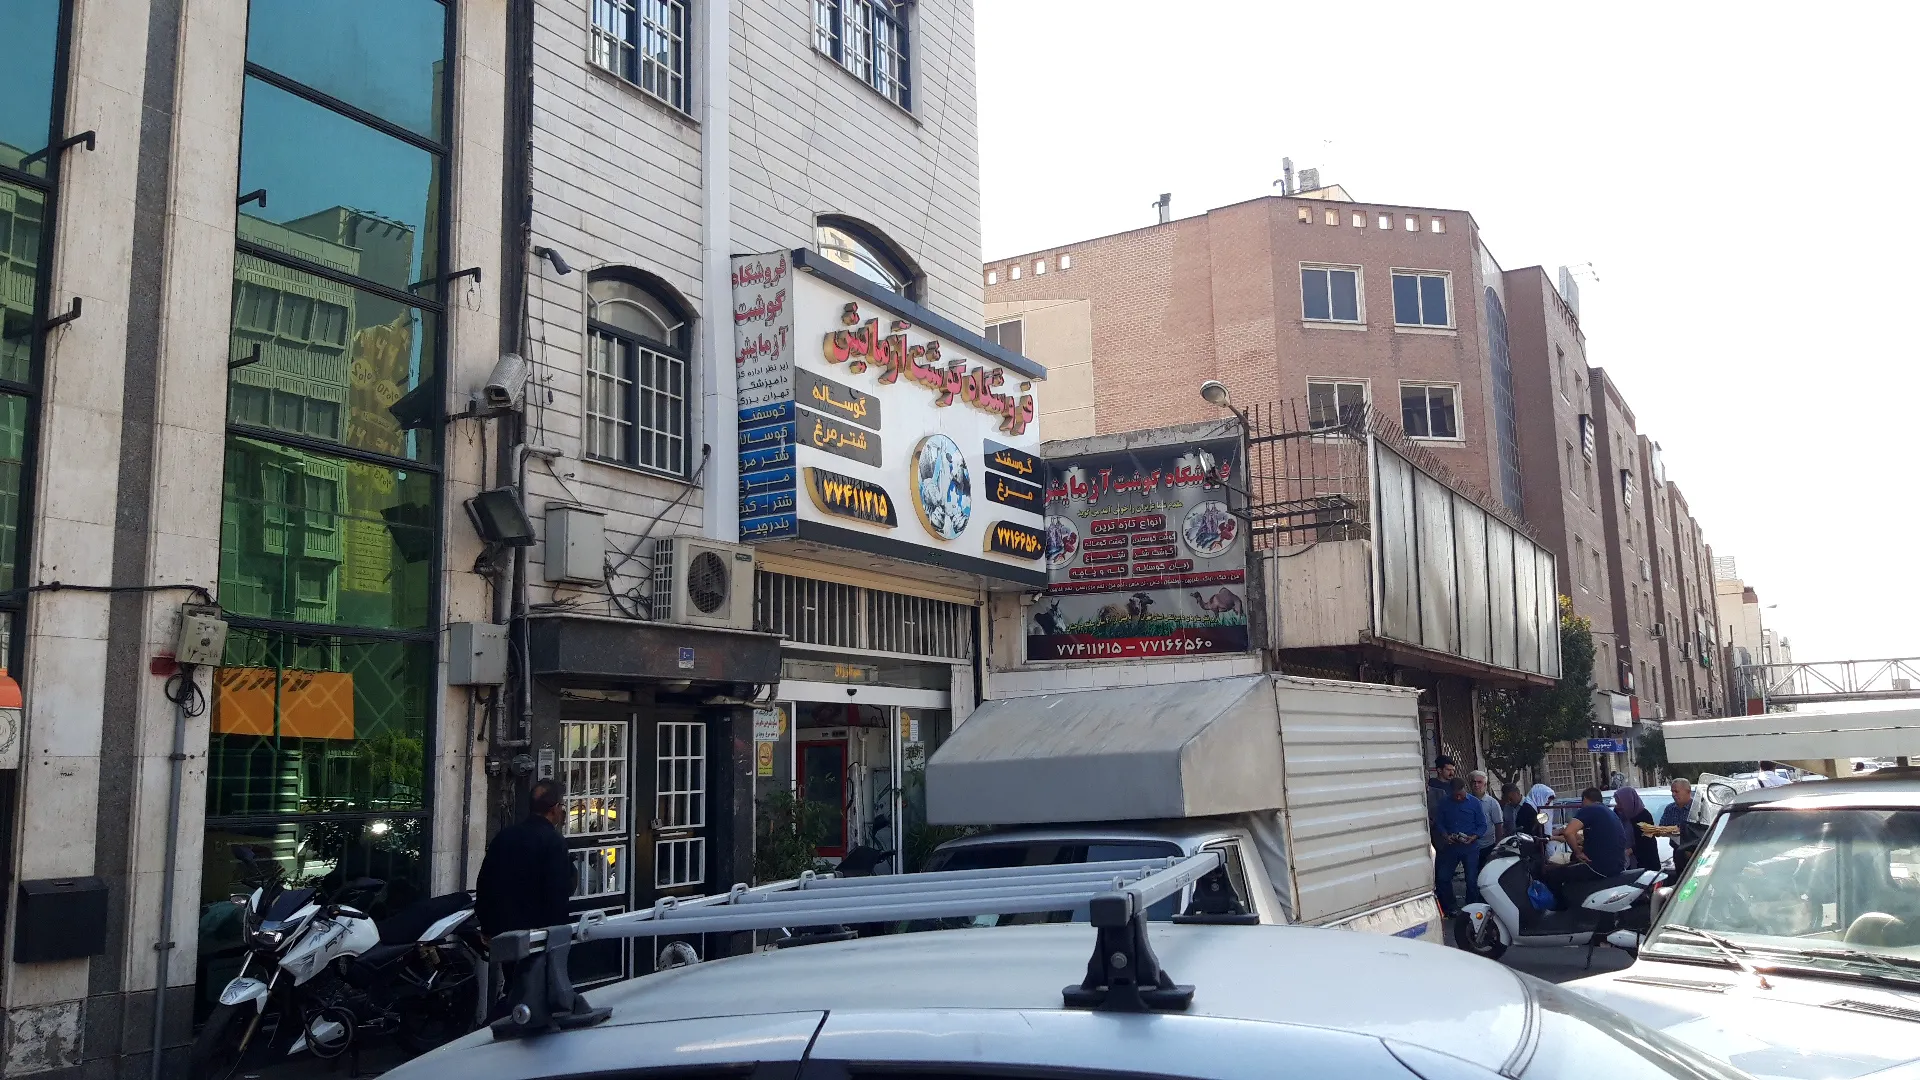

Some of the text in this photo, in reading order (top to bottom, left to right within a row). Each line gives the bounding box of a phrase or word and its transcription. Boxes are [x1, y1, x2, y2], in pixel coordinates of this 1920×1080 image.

[732, 254, 786, 290] فروشگاه
[735, 288, 786, 327] گوشت
[736, 325, 788, 368] آزمایش
[747, 367, 762, 377] اداره
[766, 364, 777, 374] نظر
[780, 361, 789, 371] زیر
[823, 302, 1033, 436] فروشگاه گوشت آزمایش
[763, 389, 790, 401] تهران
[812, 384, 867, 419] گوساله
[740, 426, 788, 445] گوسال
[994, 451, 1033, 475] گوسفند
[997, 478, 1034, 501] مرغ
[1113, 468, 1162, 497] گوشت
[773, 493, 793, 511] شتر
[823, 478, 888, 517] ۷۷۴۱۱۲۱۵
[1094, 516, 1162, 533] انواع تازه ترین
[997, 526, 1042, 553] ۷۷۱۶۶۵۶۰
[1152, 547, 1174, 556] گوشت
[1136, 561, 1190, 572] زبان گوساله
[1057, 642, 1122, 656] ۷۷۴۱۱۲۱۵
[1140, 638, 1212, 652] ۷۷۱۶۶۵۶۰
